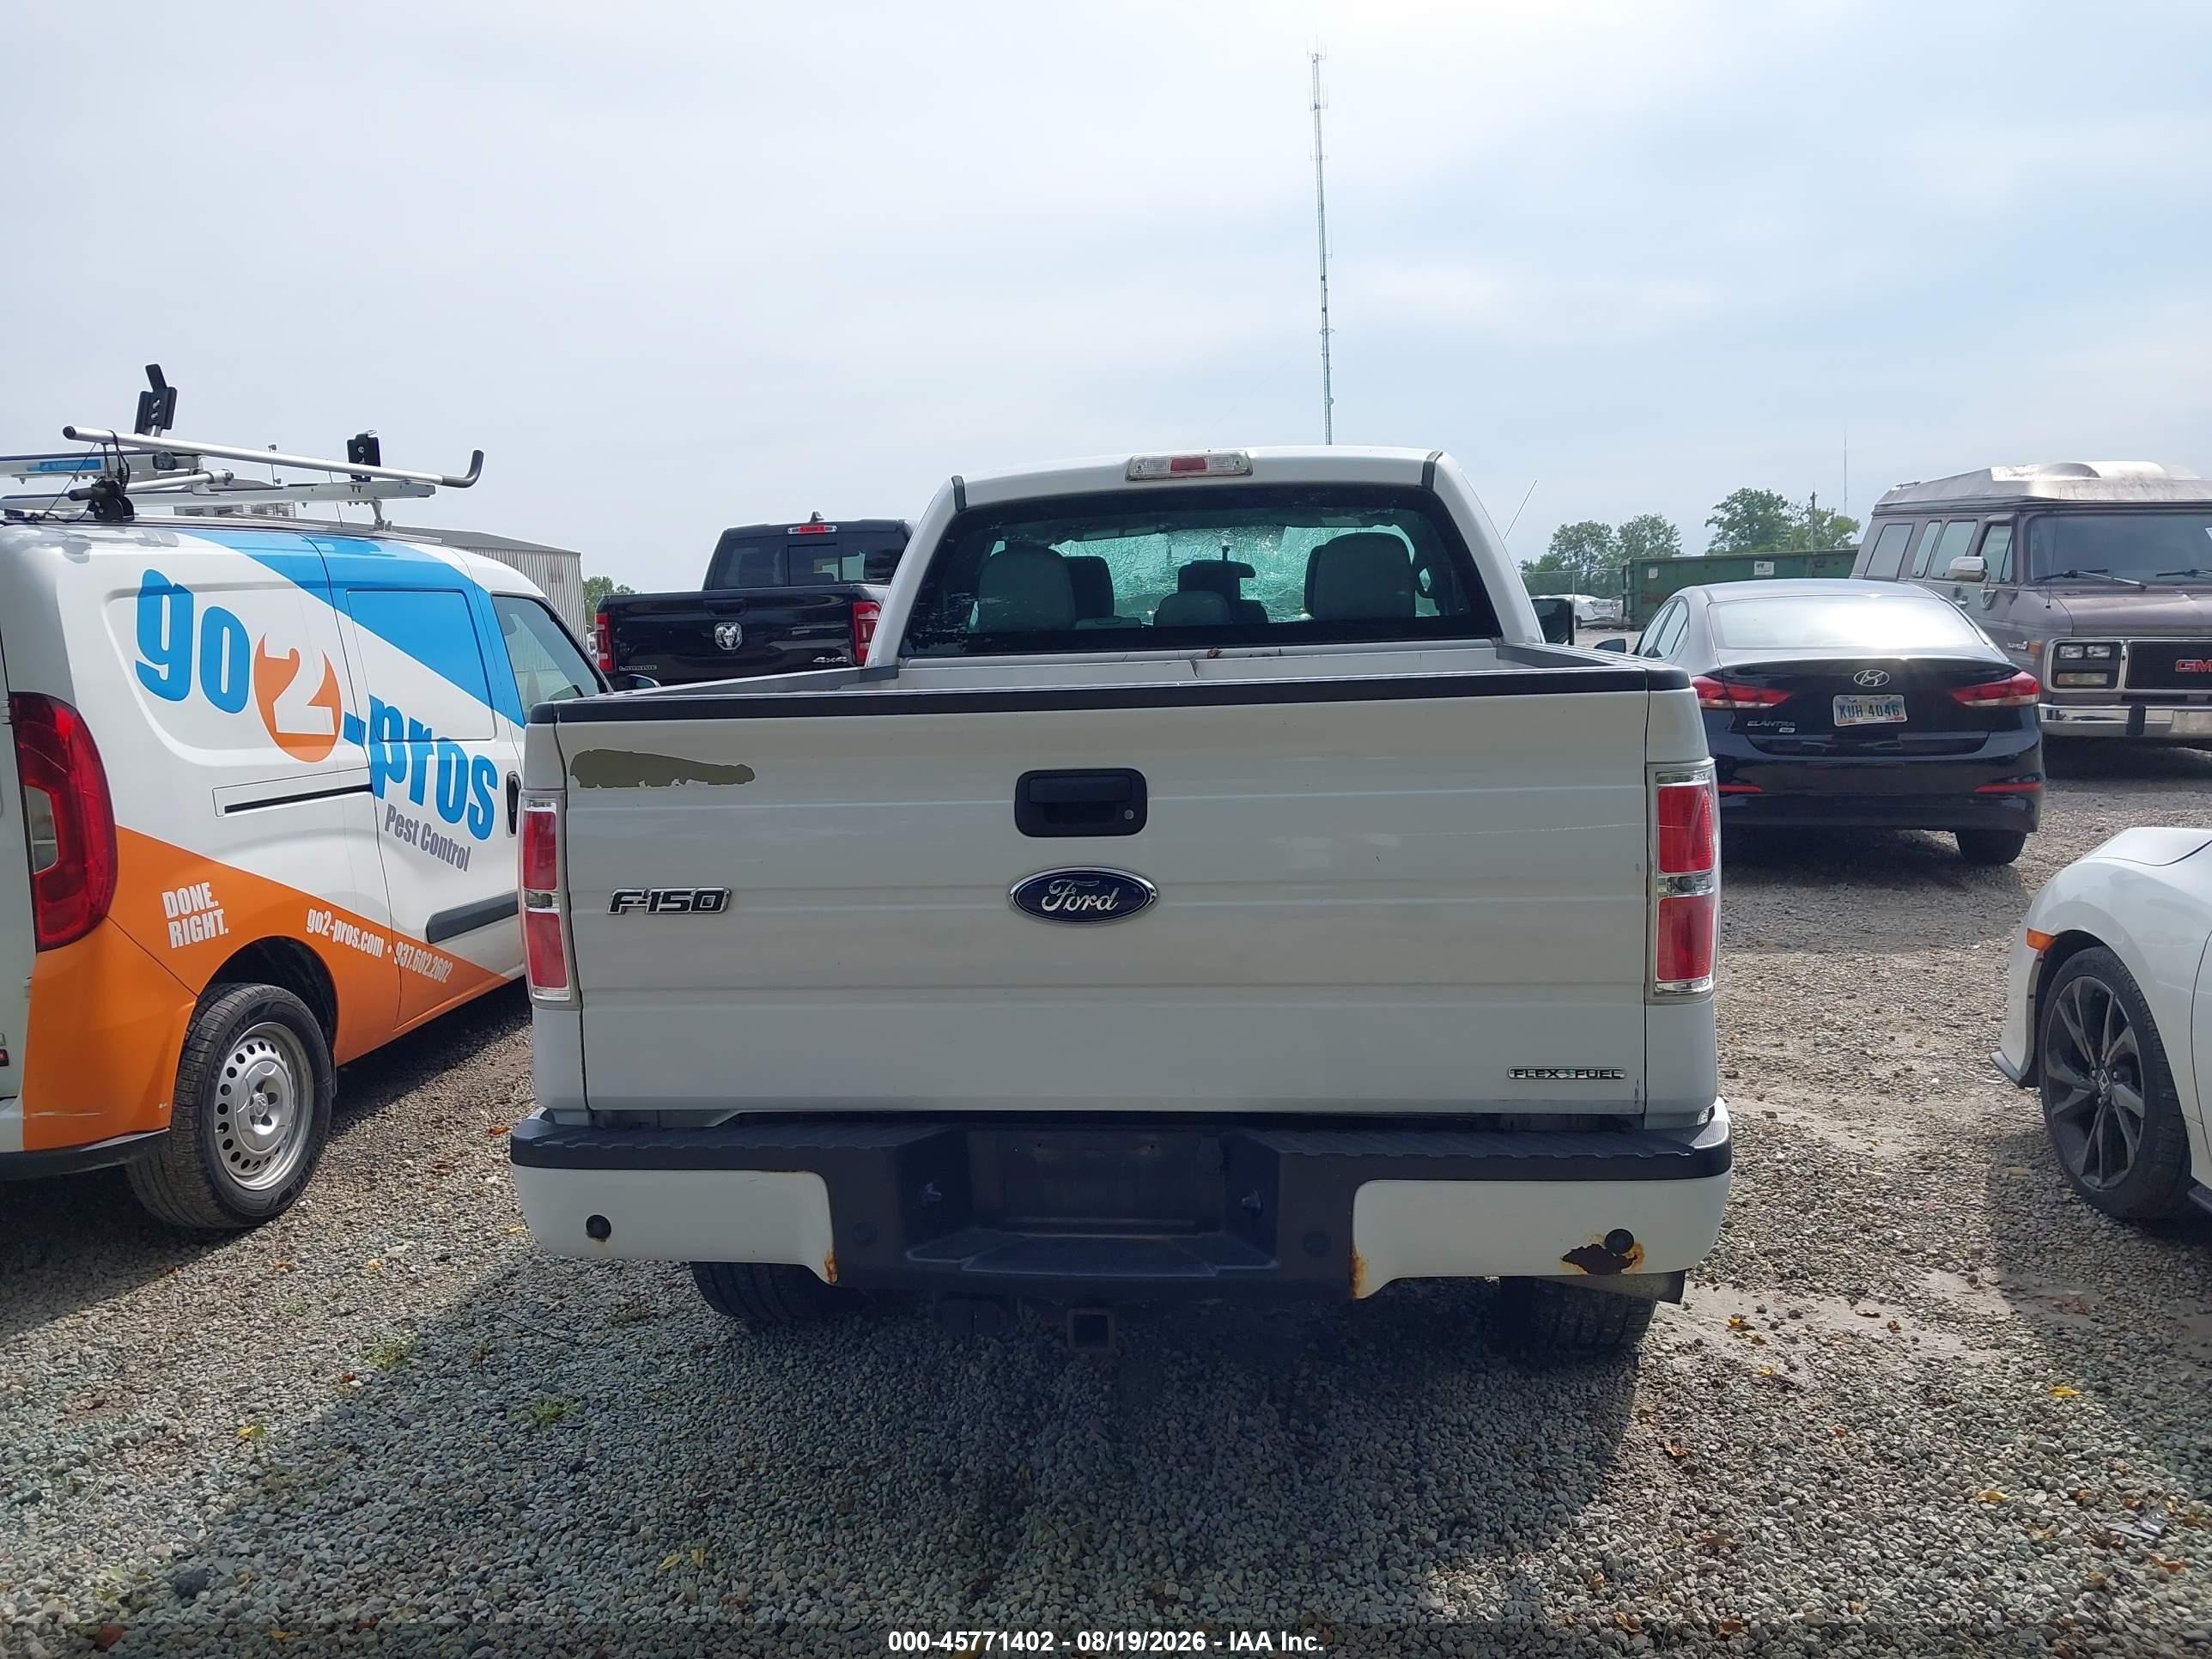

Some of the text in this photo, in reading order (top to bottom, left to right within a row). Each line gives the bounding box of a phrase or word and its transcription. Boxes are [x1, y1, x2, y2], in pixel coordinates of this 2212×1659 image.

[1840, 704, 1899, 720] KUH 4046
[385, 803, 471, 872] Pest Control
[161, 881, 219, 919] DONE.
[606, 886, 731, 915] F-150
[1041, 878, 1120, 912] Ford
[167, 908, 229, 949] RIGHT.
[306, 908, 453, 983] go2-pros.com 937.602.2602
[1512, 1067, 1625, 1079] FLEX FUEL
